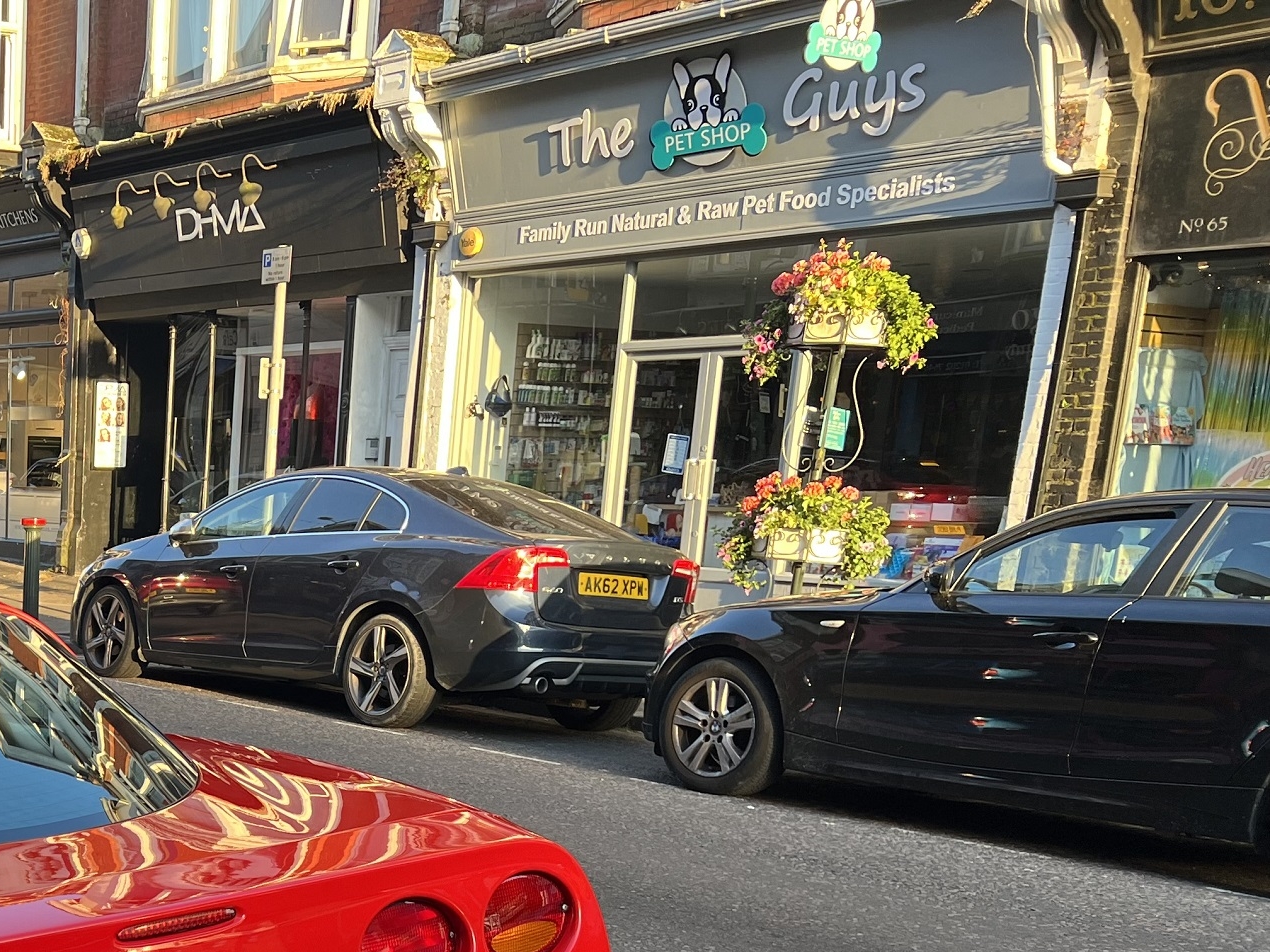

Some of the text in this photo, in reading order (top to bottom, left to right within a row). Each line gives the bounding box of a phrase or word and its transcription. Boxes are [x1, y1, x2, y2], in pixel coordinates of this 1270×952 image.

[816, 37, 872, 58] PET SHOP
[783, 63, 926, 137] Guys
[548, 108, 634, 166] The
[665, 123, 751, 154] PET SHOP
[519, 172, 956, 244] Family Run Natural & Raw Pet Food Specialists
[1206, 216, 1228, 232] 65
[460, 237, 475, 248] Yale
[584, 576, 645, 597] AK62 XPW
